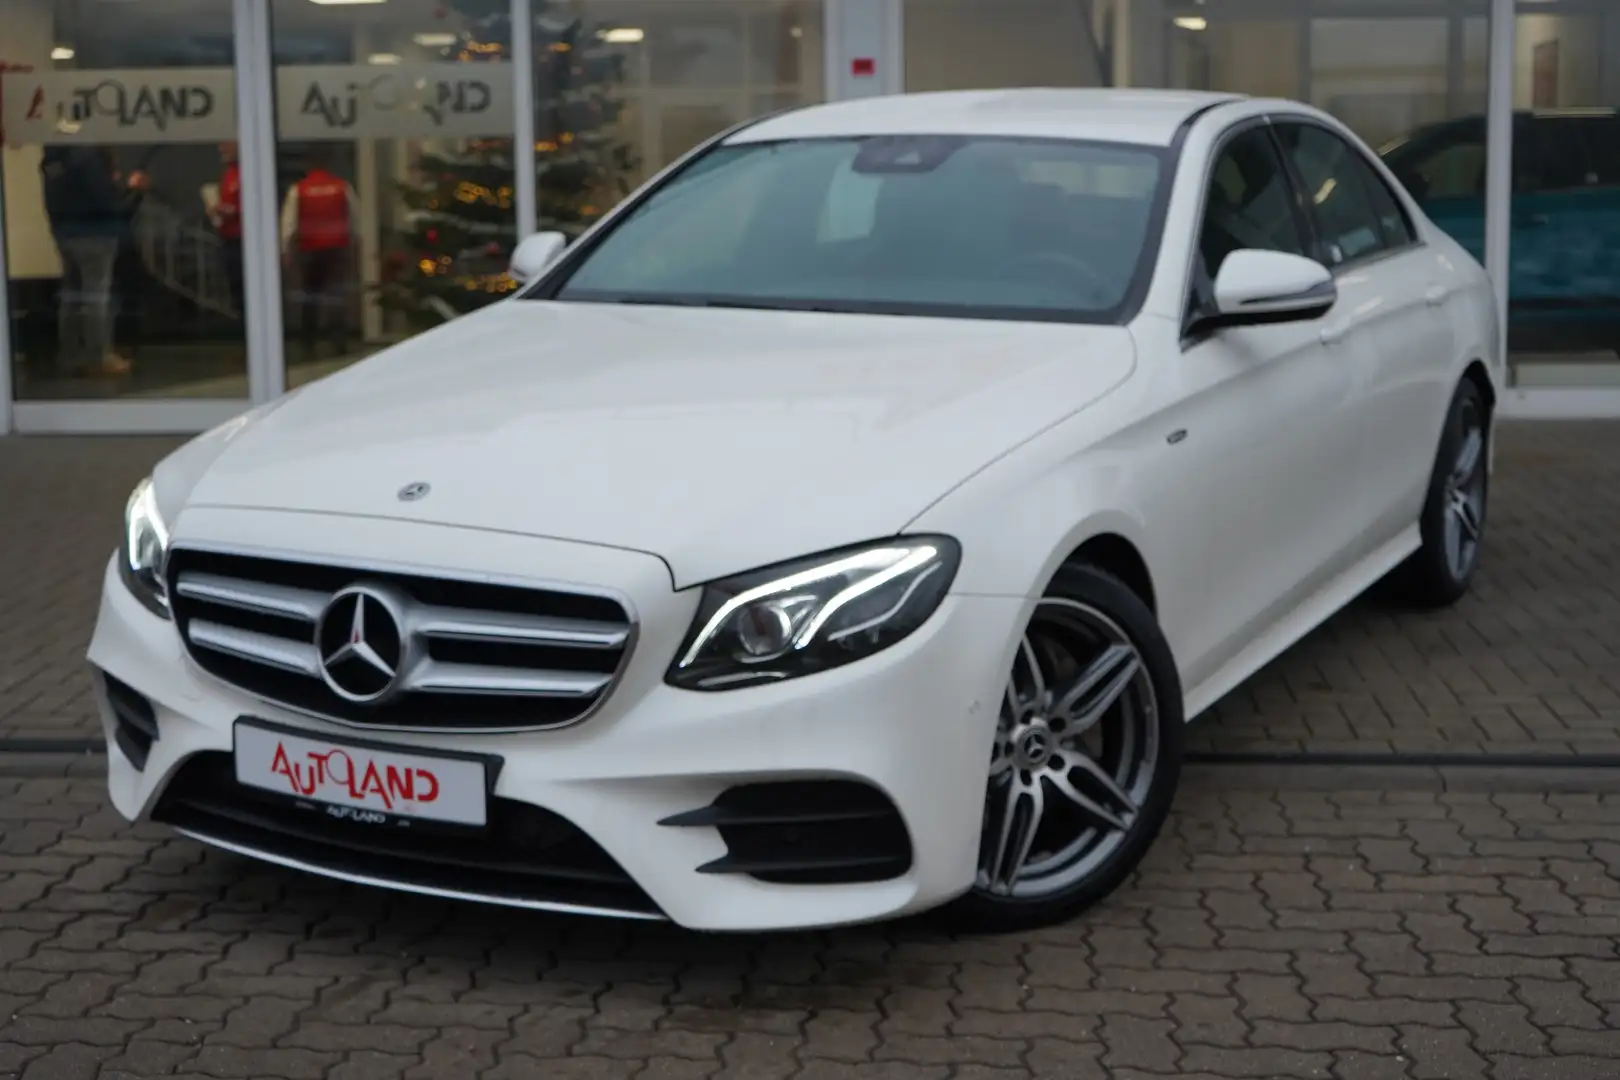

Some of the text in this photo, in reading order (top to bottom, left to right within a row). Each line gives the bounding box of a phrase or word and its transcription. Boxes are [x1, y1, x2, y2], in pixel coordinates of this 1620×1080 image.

[300, 74, 492, 128] AUOND
[271, 741, 439, 809] AUTOLAND
[327, 805, 386, 825] AUTLAND
